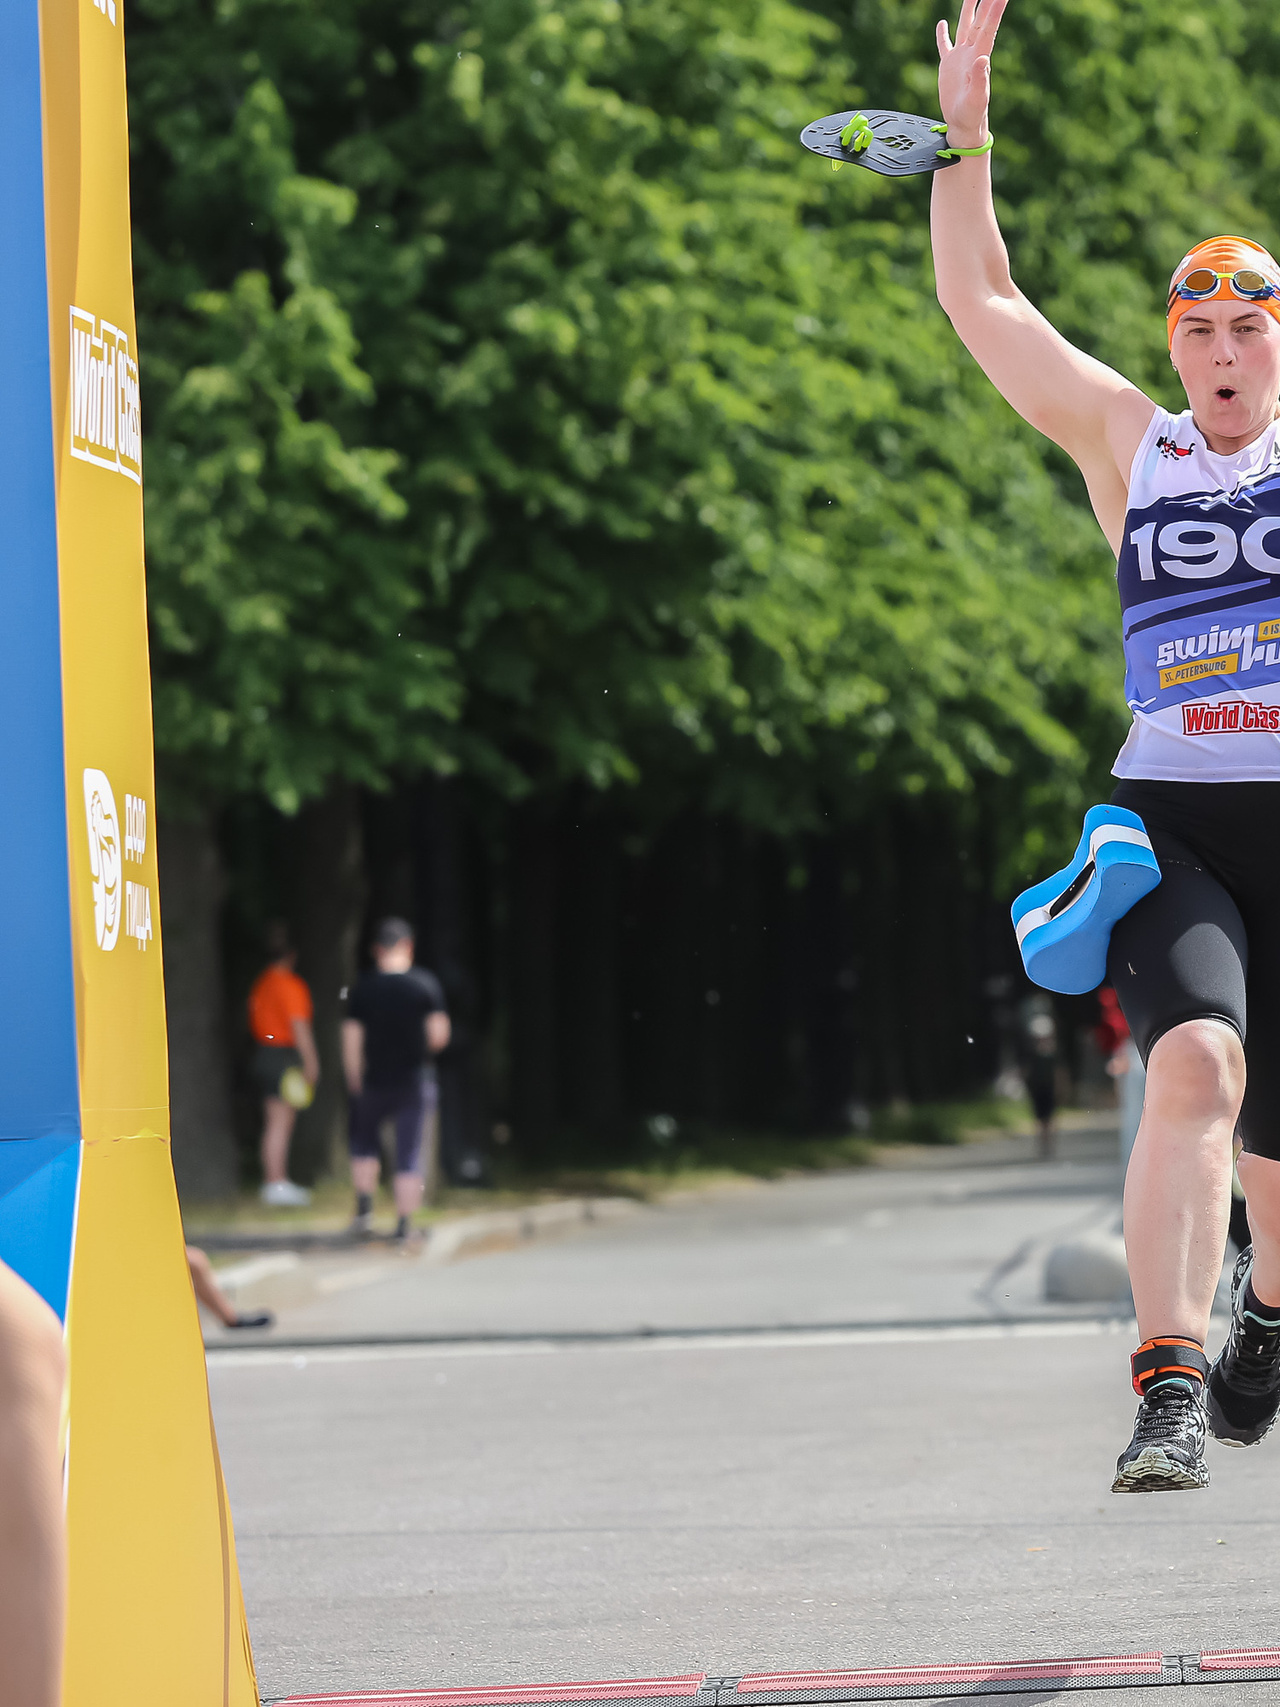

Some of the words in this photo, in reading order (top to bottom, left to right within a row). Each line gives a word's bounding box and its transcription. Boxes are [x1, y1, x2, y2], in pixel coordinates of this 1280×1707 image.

[73, 328, 116, 450] World
[1262, 625, 1269, 636] 4
[1175, 660, 1227, 680] PETERSBURG
[1186, 705, 1239, 732] World
